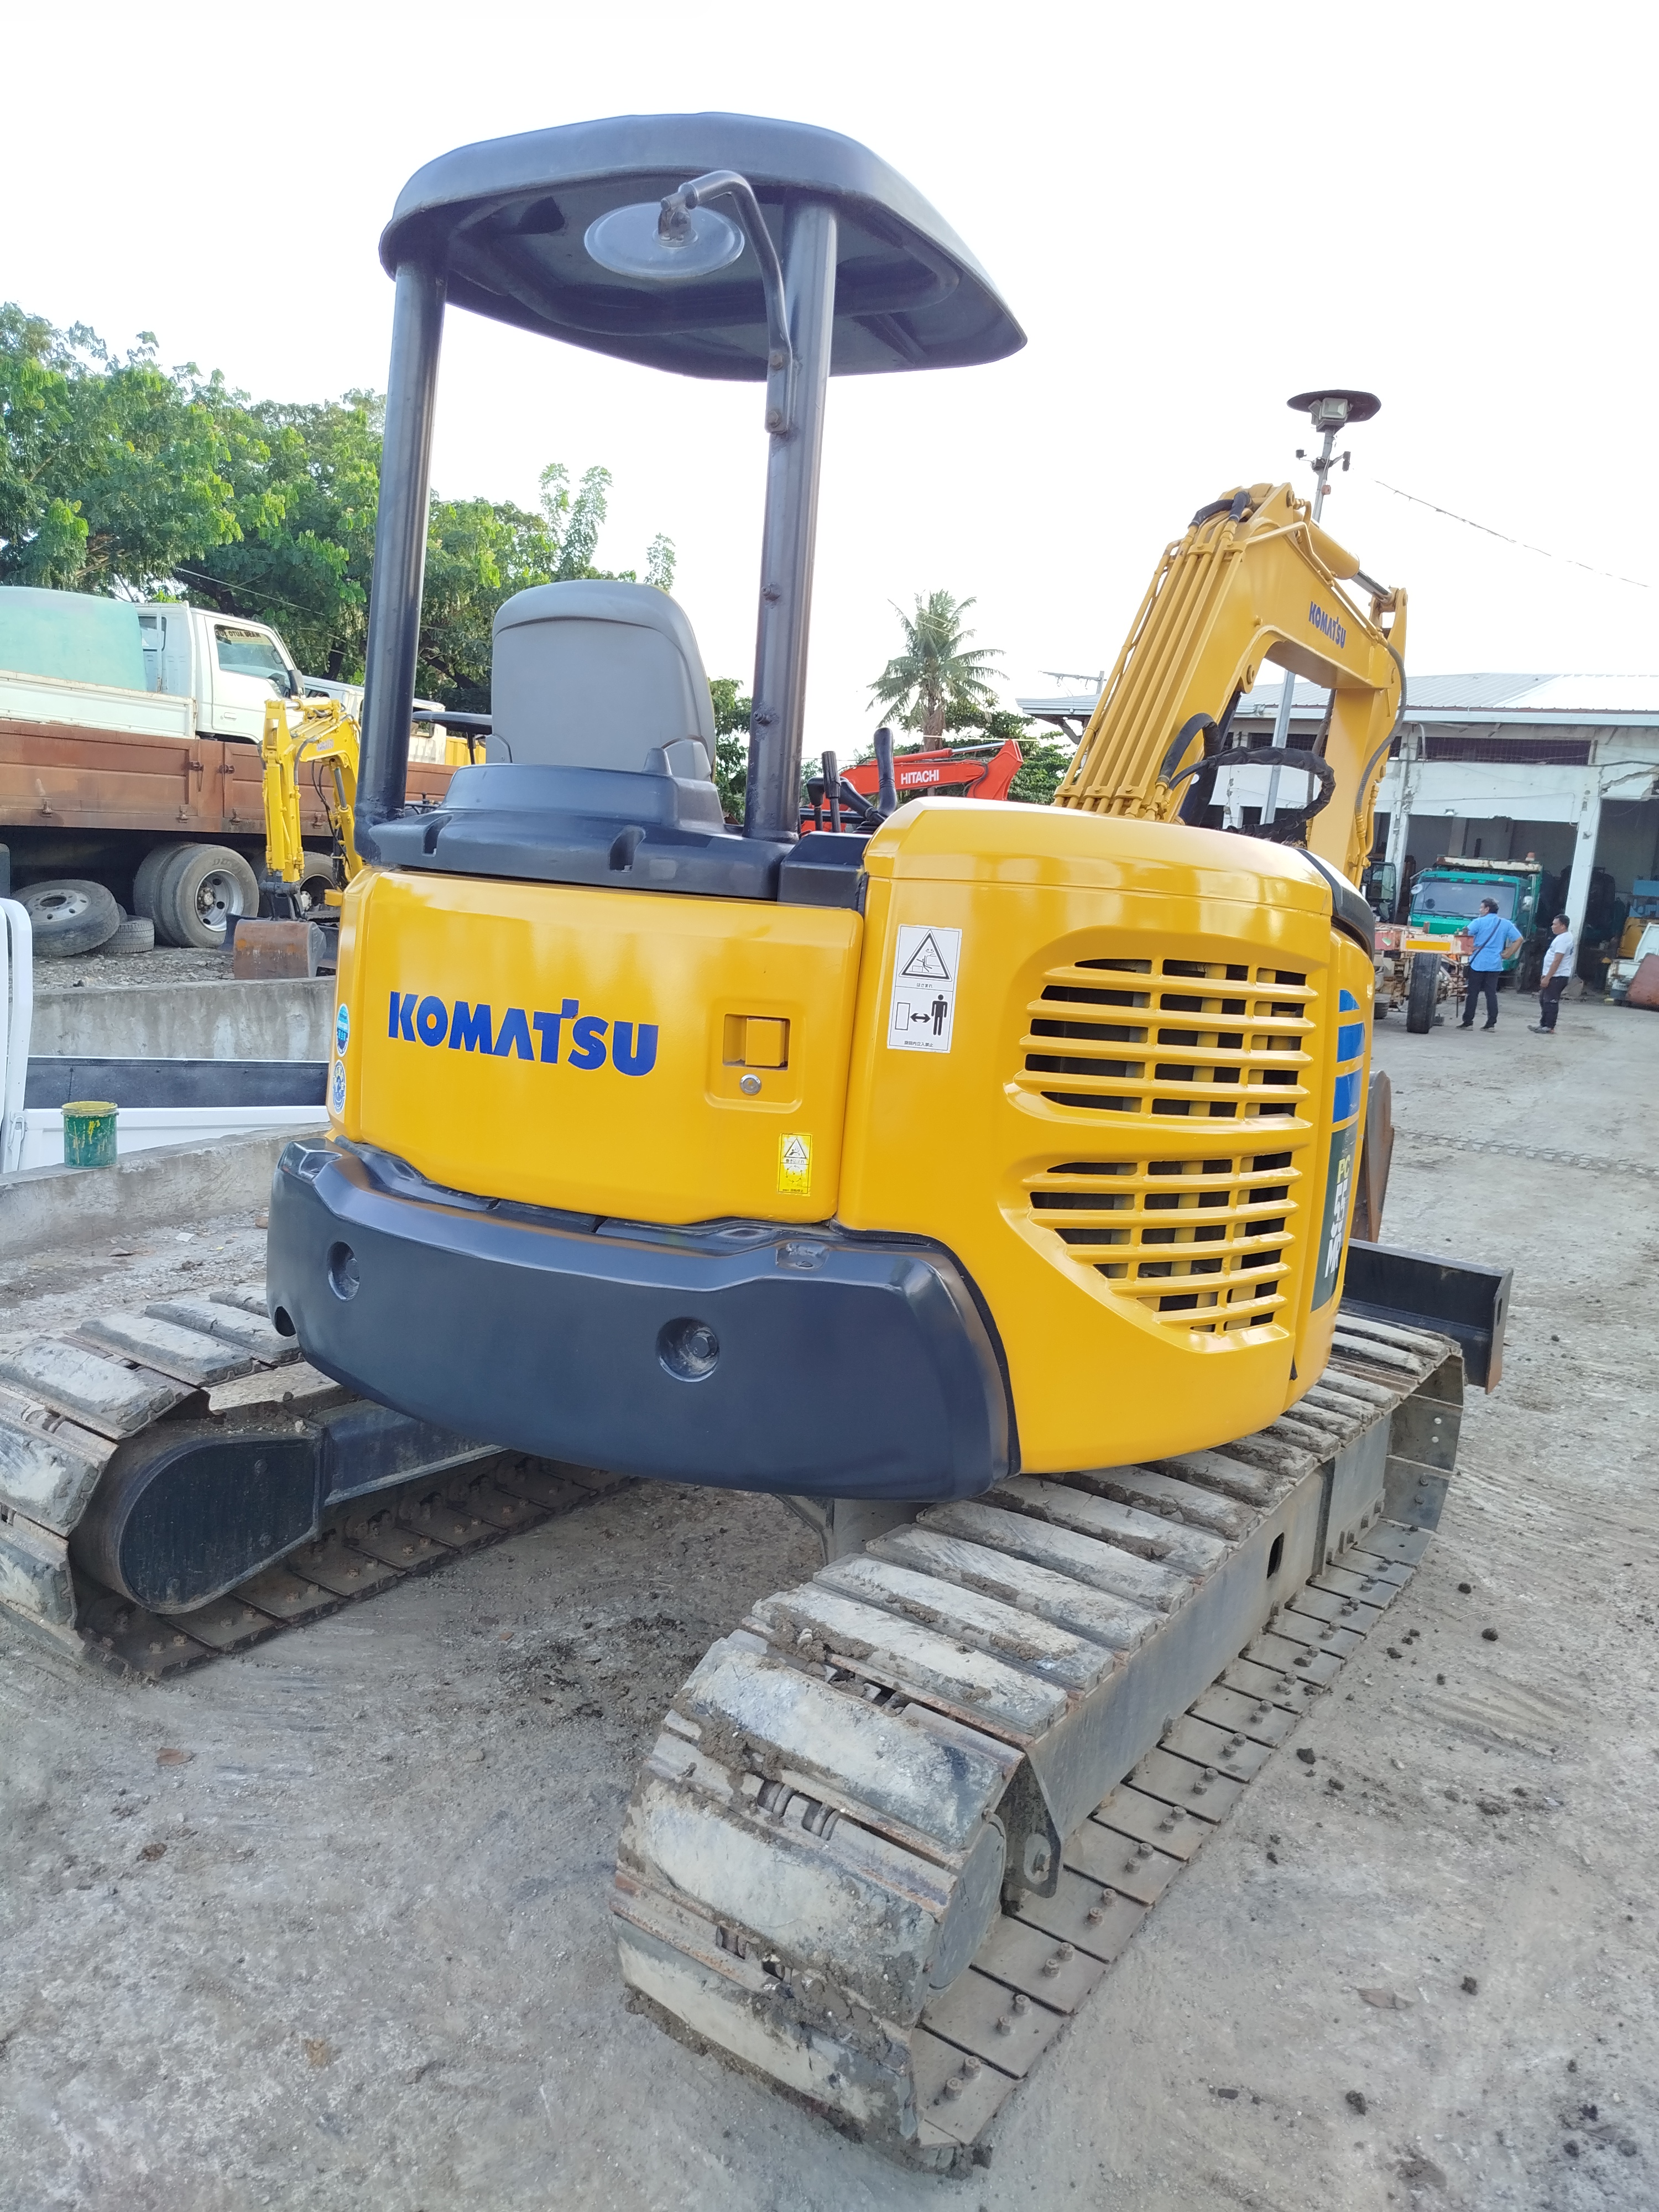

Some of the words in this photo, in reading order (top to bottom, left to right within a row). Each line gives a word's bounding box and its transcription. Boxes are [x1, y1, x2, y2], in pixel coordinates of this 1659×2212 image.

[1309, 601, 1346, 648] KOMATSU
[901, 769, 940, 785] HITACHI
[389, 992, 659, 1076] KOMATSU
[1337, 1154, 1351, 1183] PC
[1324, 1232, 1342, 1279] MR
